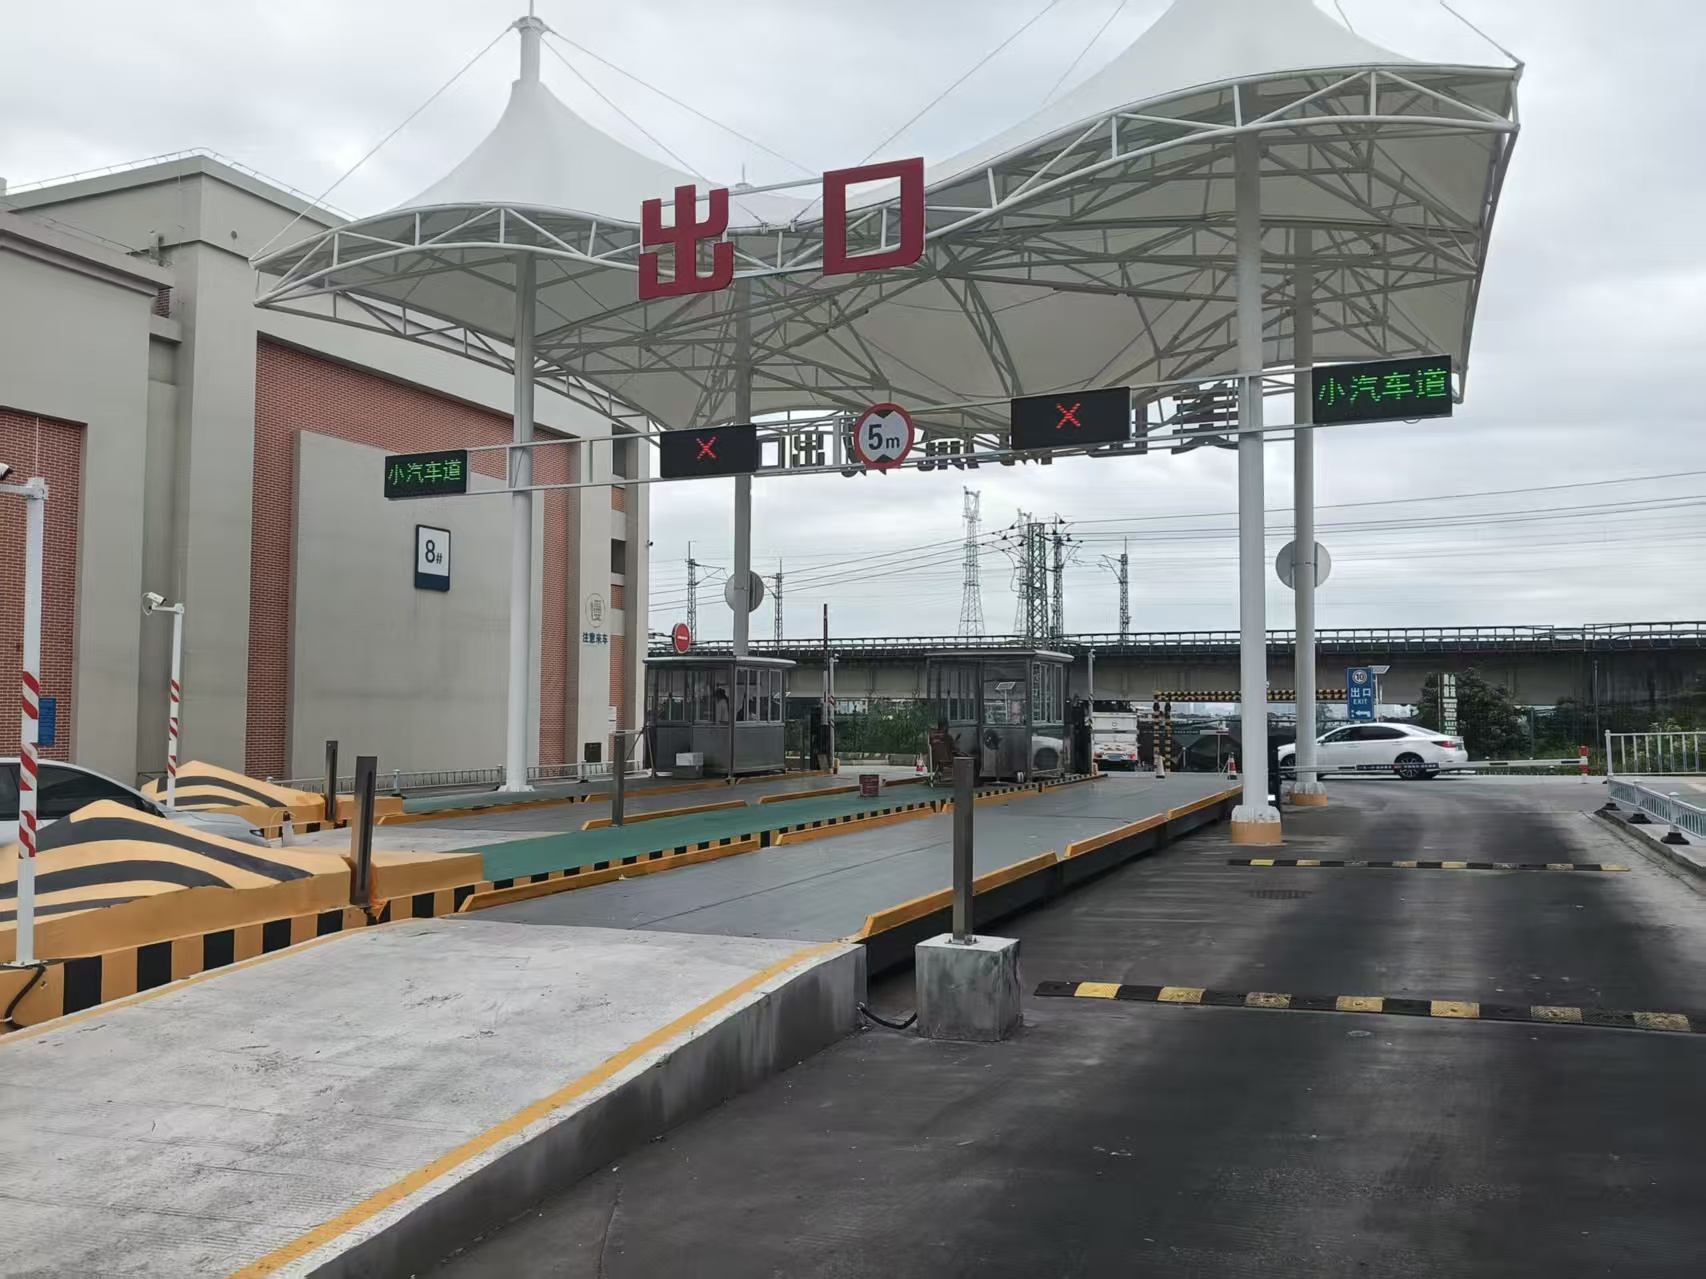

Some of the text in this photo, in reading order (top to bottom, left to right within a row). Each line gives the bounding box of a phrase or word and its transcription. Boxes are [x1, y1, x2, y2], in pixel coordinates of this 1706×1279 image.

[639, 157, 924, 300] 出口
[1318, 368, 1447, 405] 小汽车道
[868, 424, 900, 450] 5m
[388, 459, 462, 485] 小汽车道
[425, 539, 443, 565] 8#
[582, 632, 609, 645] 注意来车
[1350, 687, 1371, 698] 出口
